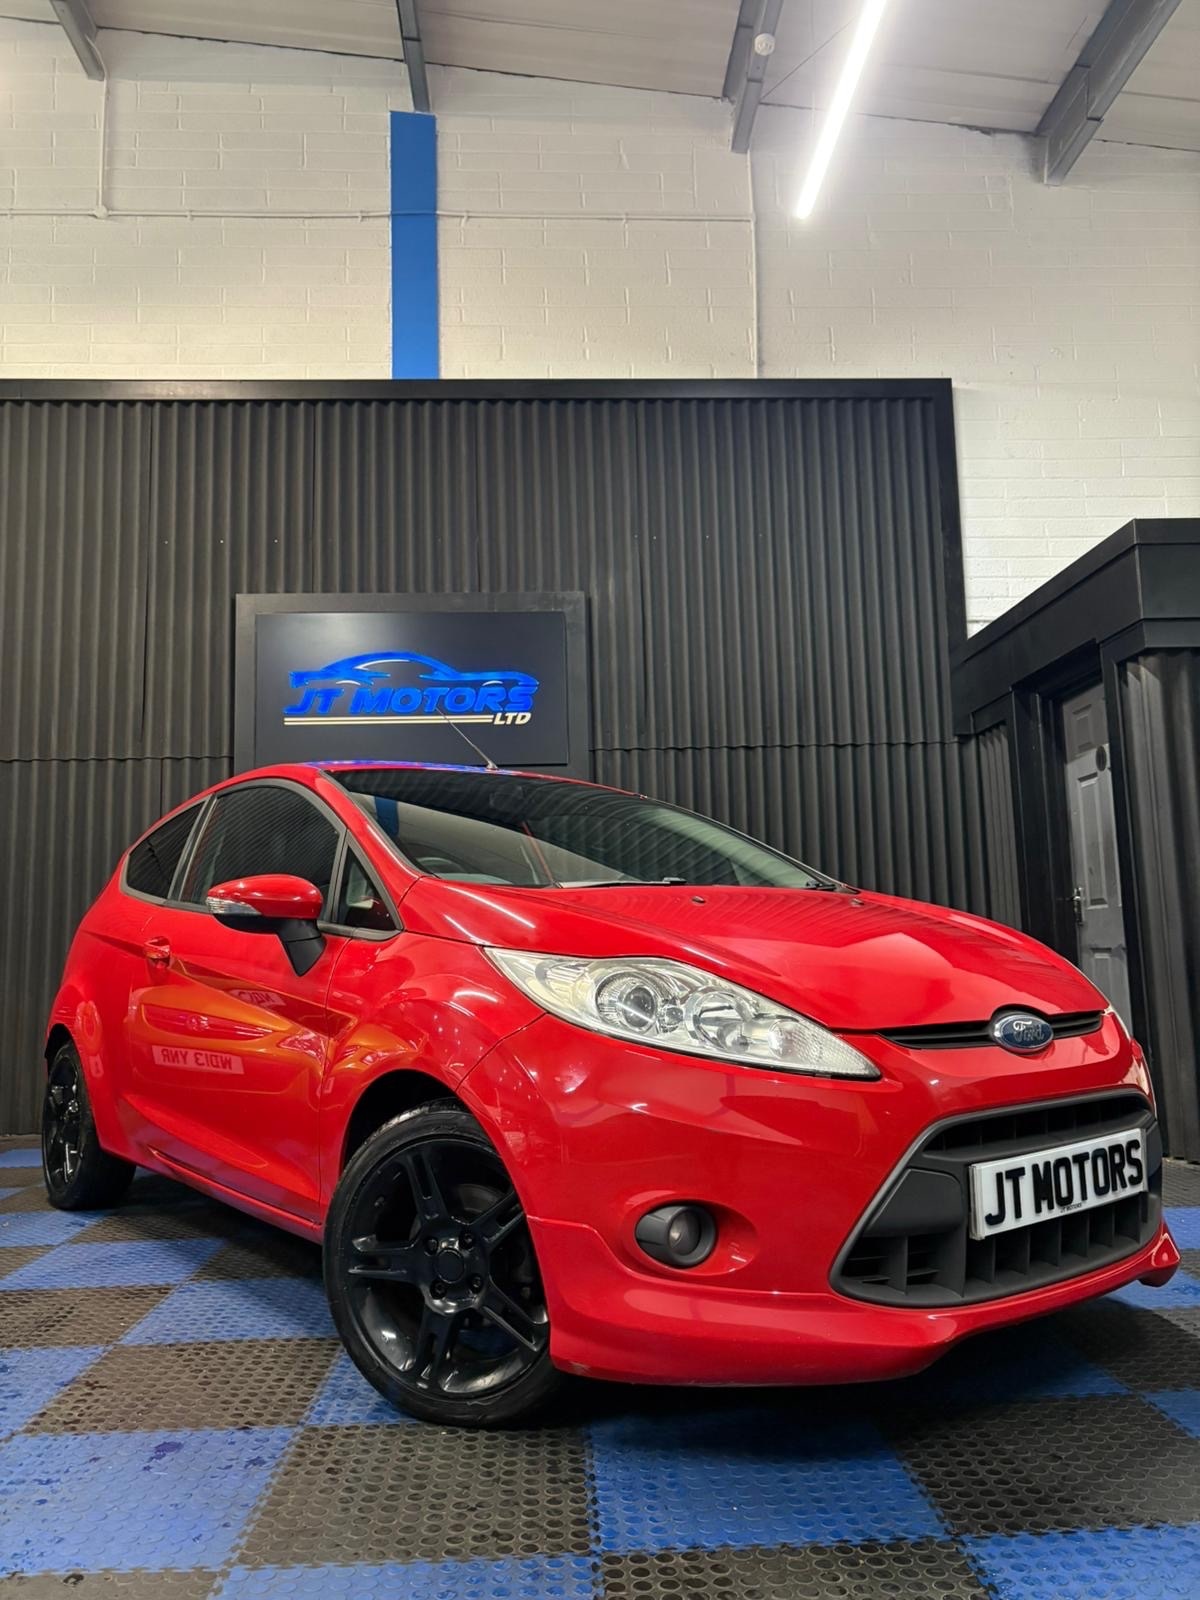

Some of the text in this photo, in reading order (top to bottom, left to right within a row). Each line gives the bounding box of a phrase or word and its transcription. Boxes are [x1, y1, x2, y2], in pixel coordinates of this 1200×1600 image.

[283, 686, 538, 714] JT MOTORS
[493, 712, 532, 725] LTD
[1013, 1020, 1044, 1042] Ford
[984, 1139, 1144, 1226] JT MOTORS
